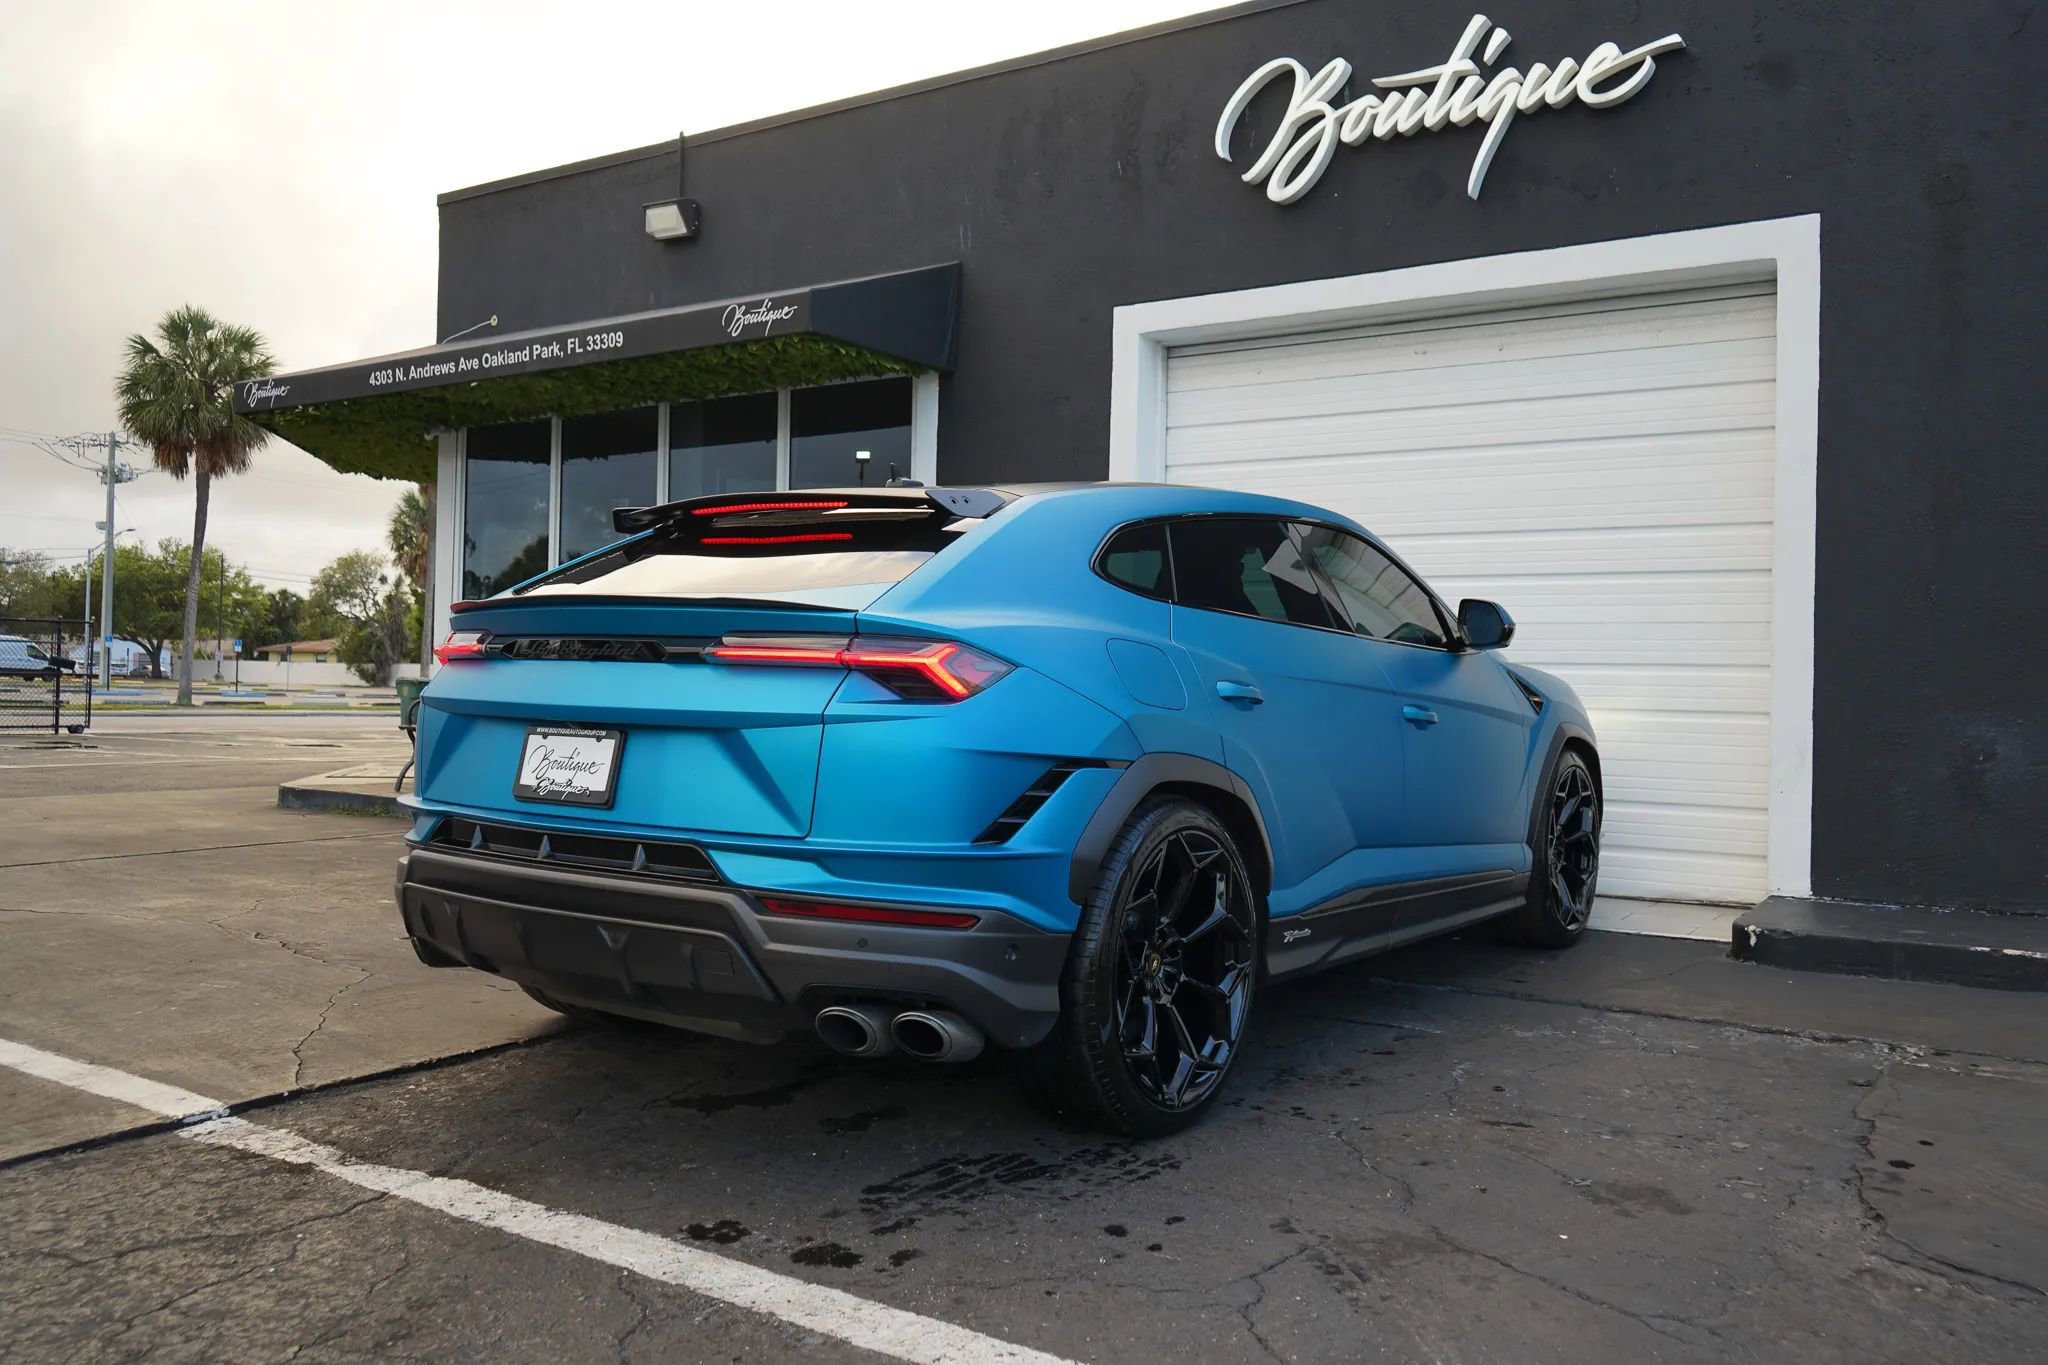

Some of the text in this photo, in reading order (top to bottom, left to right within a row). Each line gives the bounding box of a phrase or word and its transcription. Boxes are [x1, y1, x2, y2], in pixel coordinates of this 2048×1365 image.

[1215, 13, 1687, 206] Boutique
[722, 298, 798, 337] Boutique
[369, 331, 624, 386] 4303 N. Andrews Ave Oakland Park, FL 33309
[243, 379, 290, 408] Boutique
[527, 744, 606, 781] Boutique
